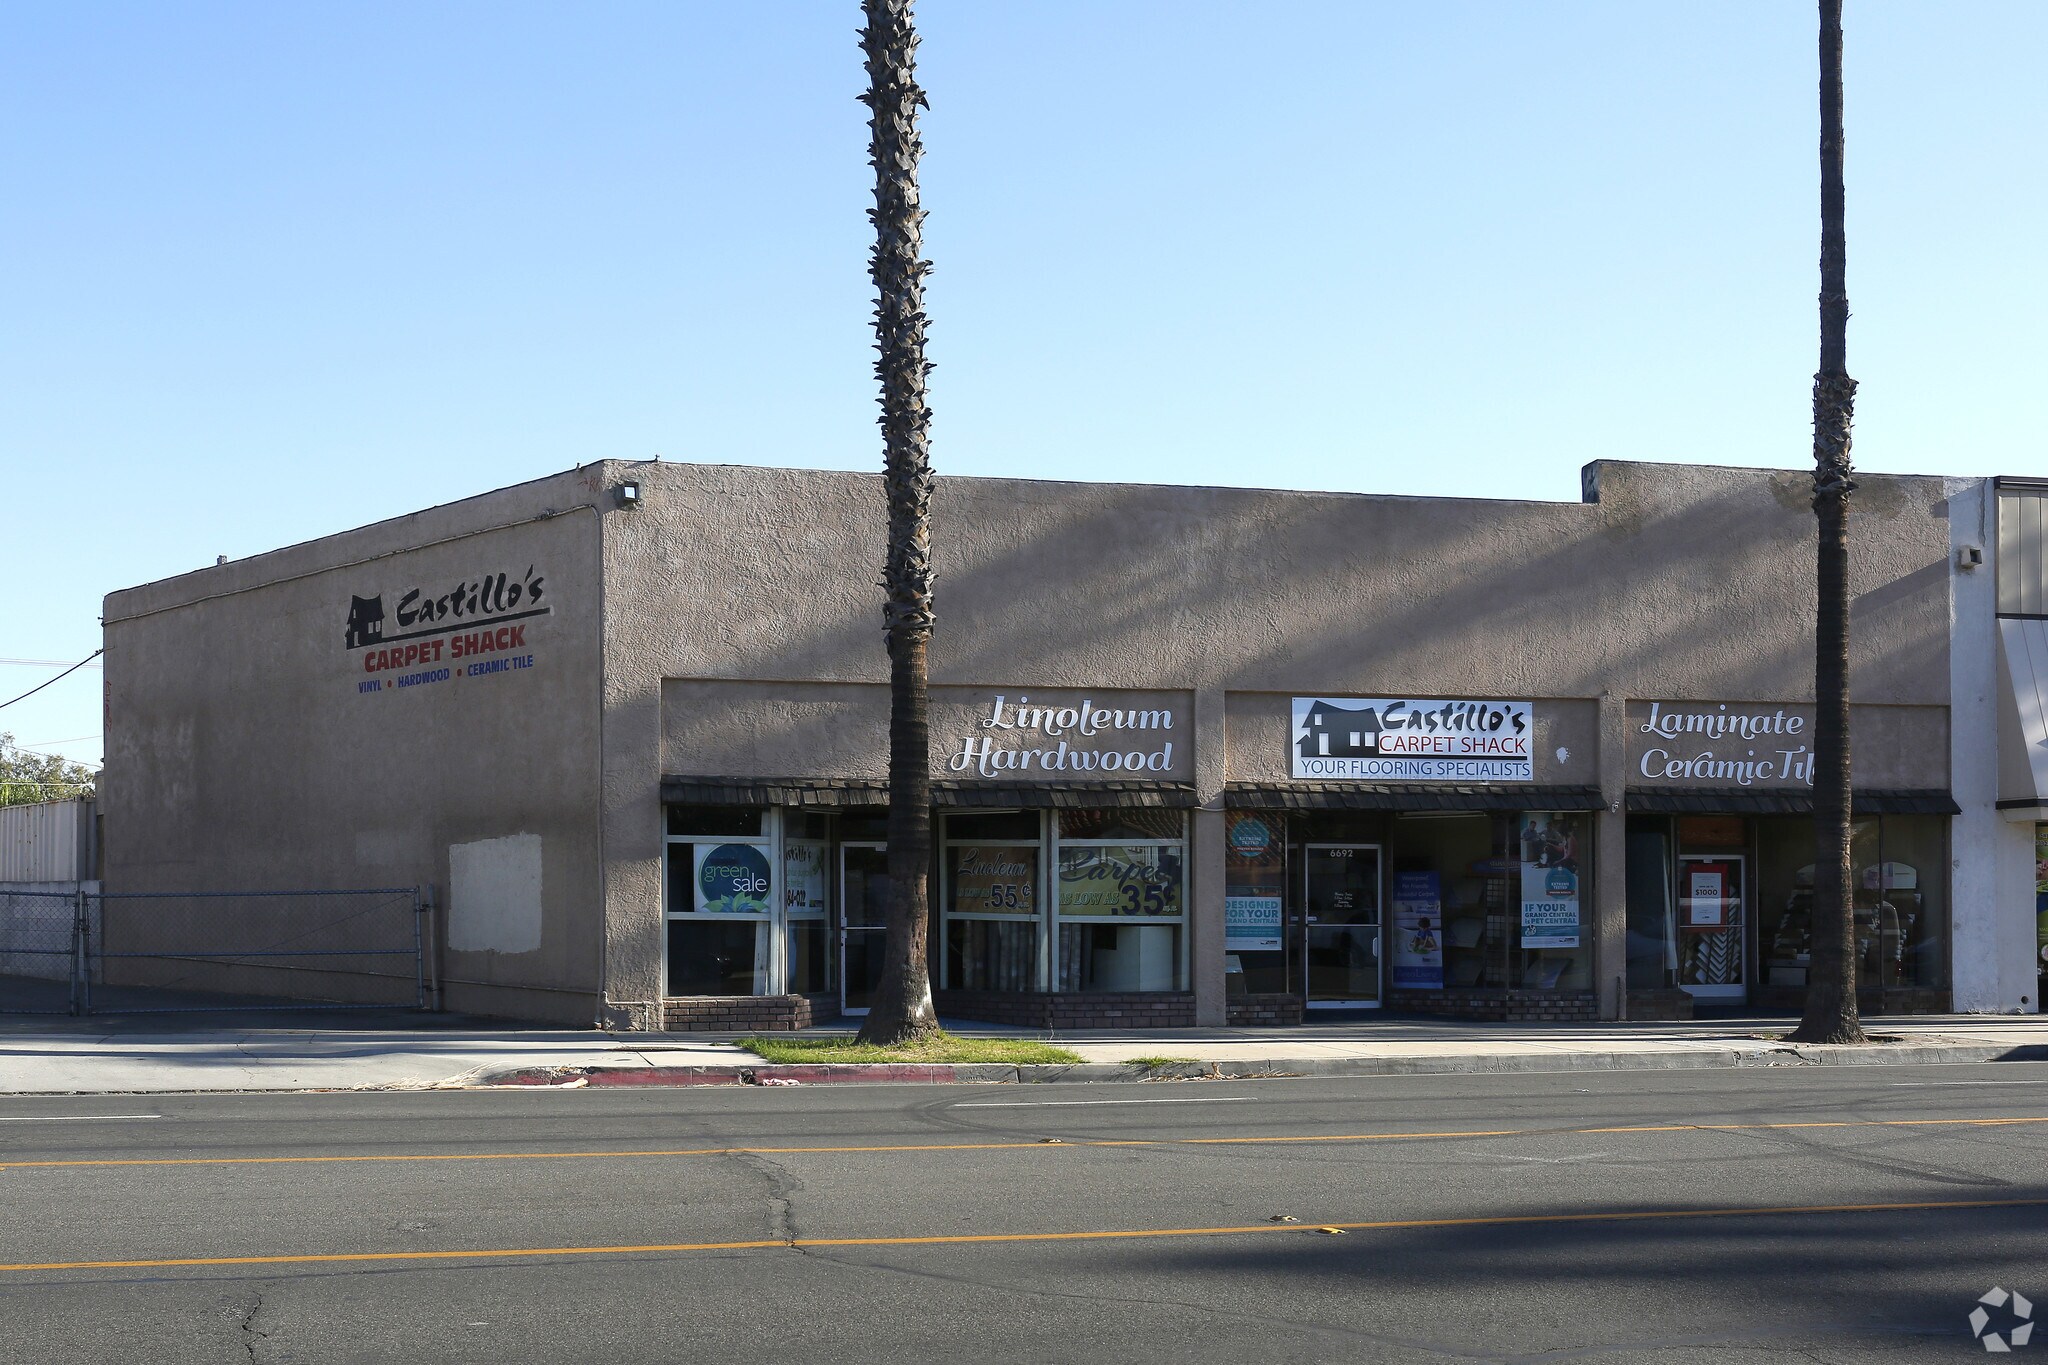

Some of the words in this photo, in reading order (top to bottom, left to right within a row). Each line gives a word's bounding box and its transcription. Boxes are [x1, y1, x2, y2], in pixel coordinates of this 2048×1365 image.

[396, 564, 545, 627] Castillo's
[364, 638, 444, 673] CARPET
[450, 624, 527, 659] SHACK
[358, 679, 382, 694] VINYL
[397, 668, 450, 688] HARDWOOD
[467, 658, 510, 677] CERAMIC
[512, 654, 534, 670] TILE
[982, 695, 1176, 736] Linoleum
[1380, 701, 1527, 735] Castillo's
[1640, 702, 1804, 740] Laminate
[1379, 735, 1456, 753] CARPET
[1461, 736, 1528, 754] SHACK
[950, 736, 1175, 778] Hardwood
[1301, 755, 1347, 770] YOUR
[1350, 755, 1433, 771] FLOORING
[1436, 756, 1531, 772] SPECIALISTS
[1640, 748, 1774, 786] Ceramic
[1775, 745, 1815, 786] Til
[958, 847, 1027, 877] Linoleum
[1329, 849, 1354, 858] 6692
[704, 864, 750, 883] green
[732, 872, 768, 892] sale
[1073, 891, 1103, 905] LOW
[1103, 891, 1120, 905] AS
[1695, 888, 1718, 896] $1000
[1225, 901, 1278, 909] DESIGNED
[1246, 910, 1279, 918] YOUR
[1525, 904, 1534, 912] IF
[1536, 904, 1567, 912] YOUR
